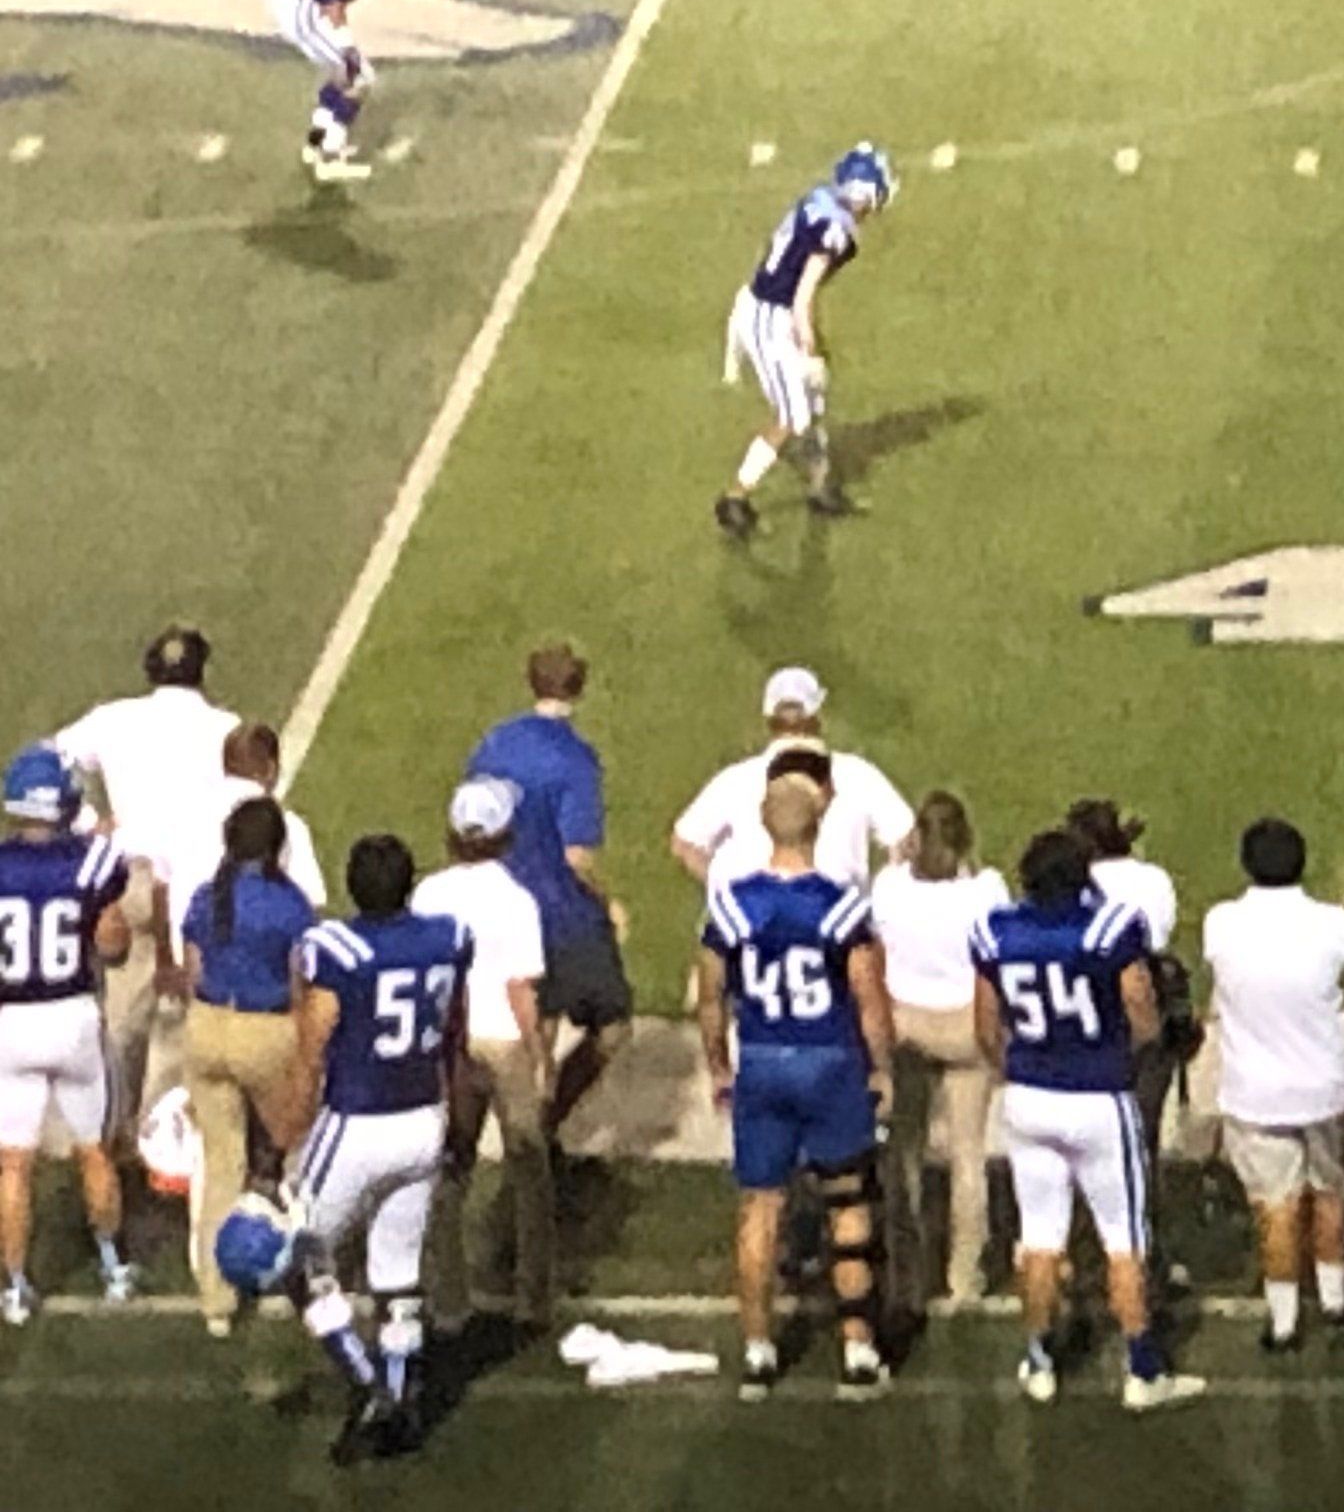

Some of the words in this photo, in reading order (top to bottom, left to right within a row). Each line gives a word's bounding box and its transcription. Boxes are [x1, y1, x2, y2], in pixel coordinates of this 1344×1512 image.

[0, 898, 81, 981] 36
[740, 945, 832, 1021] 46
[1001, 962, 1100, 1040] 54
